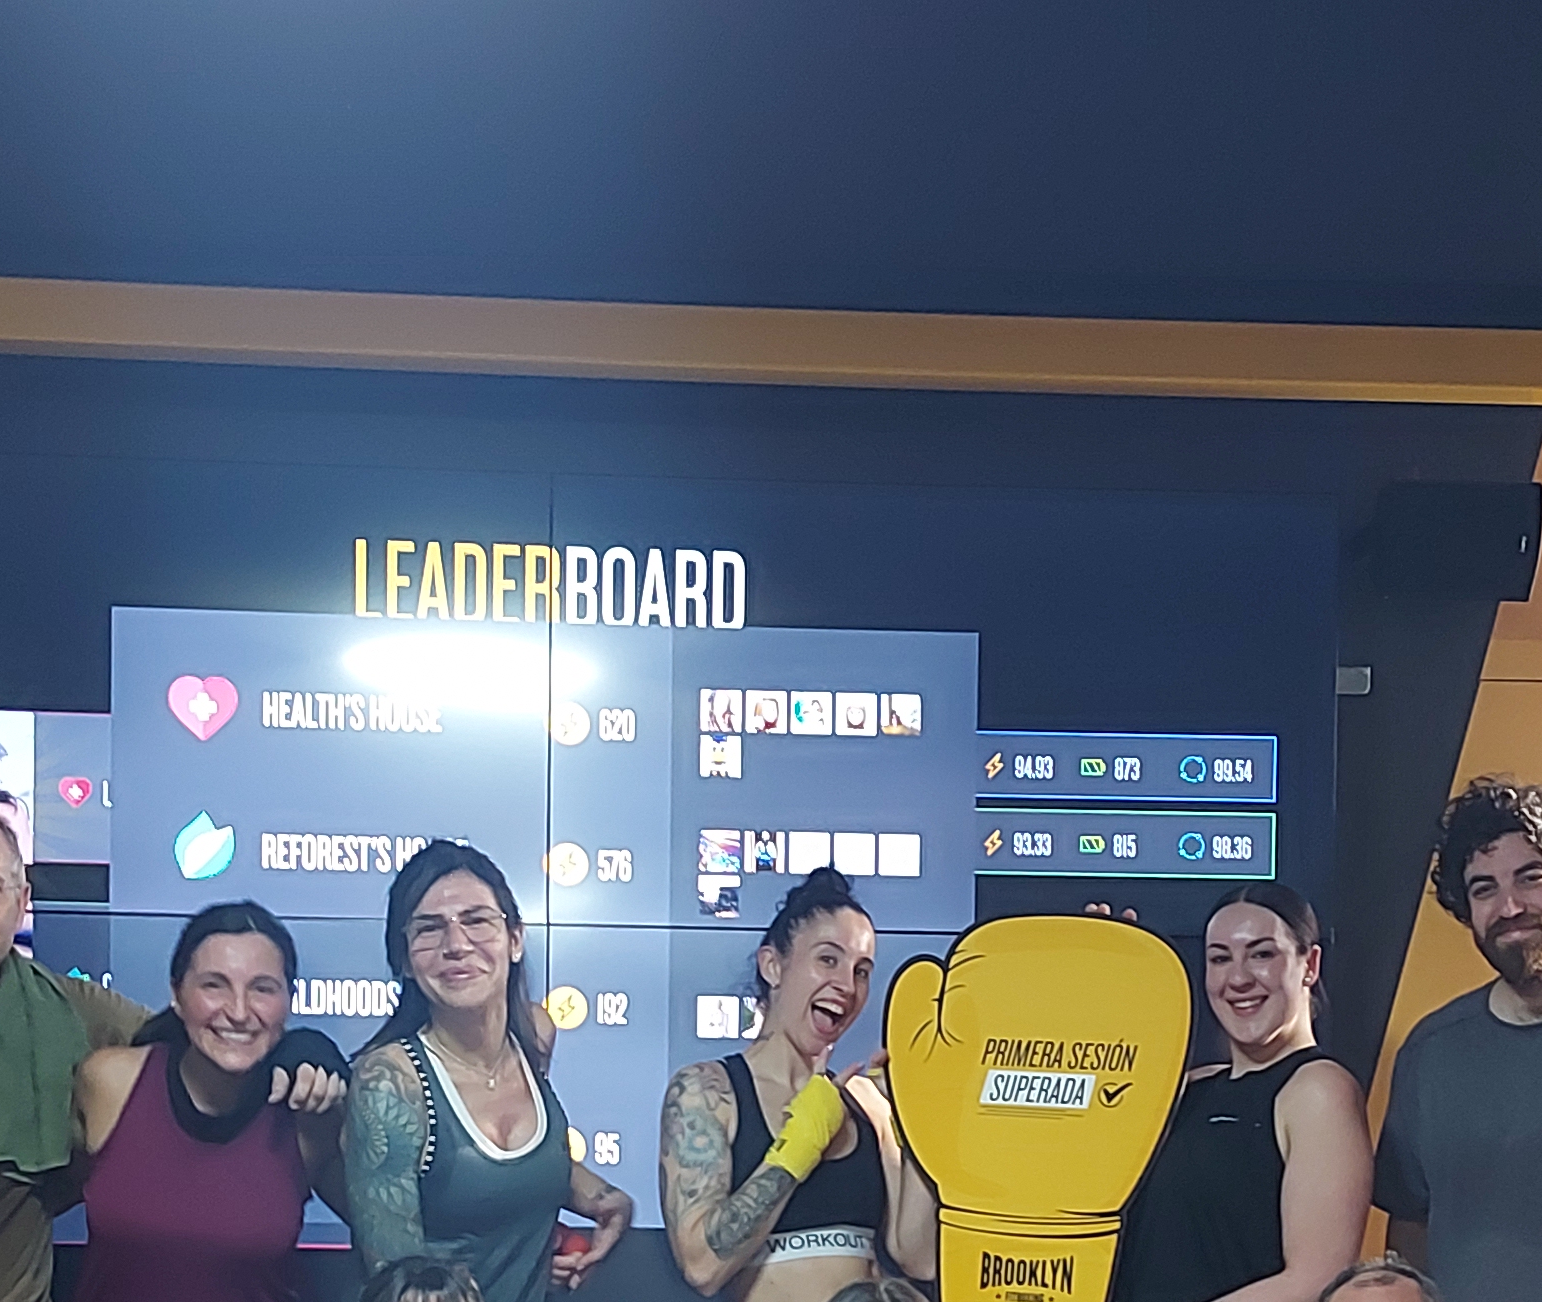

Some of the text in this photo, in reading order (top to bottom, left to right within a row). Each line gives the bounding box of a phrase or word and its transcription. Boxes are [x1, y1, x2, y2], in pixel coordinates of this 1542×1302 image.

[354, 537, 747, 629] LEADERBOARD
[261, 690, 366, 732] HEALTH'S
[597, 708, 636, 742] 620
[260, 832, 394, 873] REFOREST'S
[596, 849, 633, 882] 576
[597, 992, 628, 1026] 192
[981, 1037, 1139, 1073] PRIMERA SESIÓN
[988, 1073, 1087, 1107] SUPERADA
[594, 1131, 620, 1165] 95
[766, 1231, 865, 1254] WORKOUT
[979, 1250, 1074, 1296] BROOKLYN
